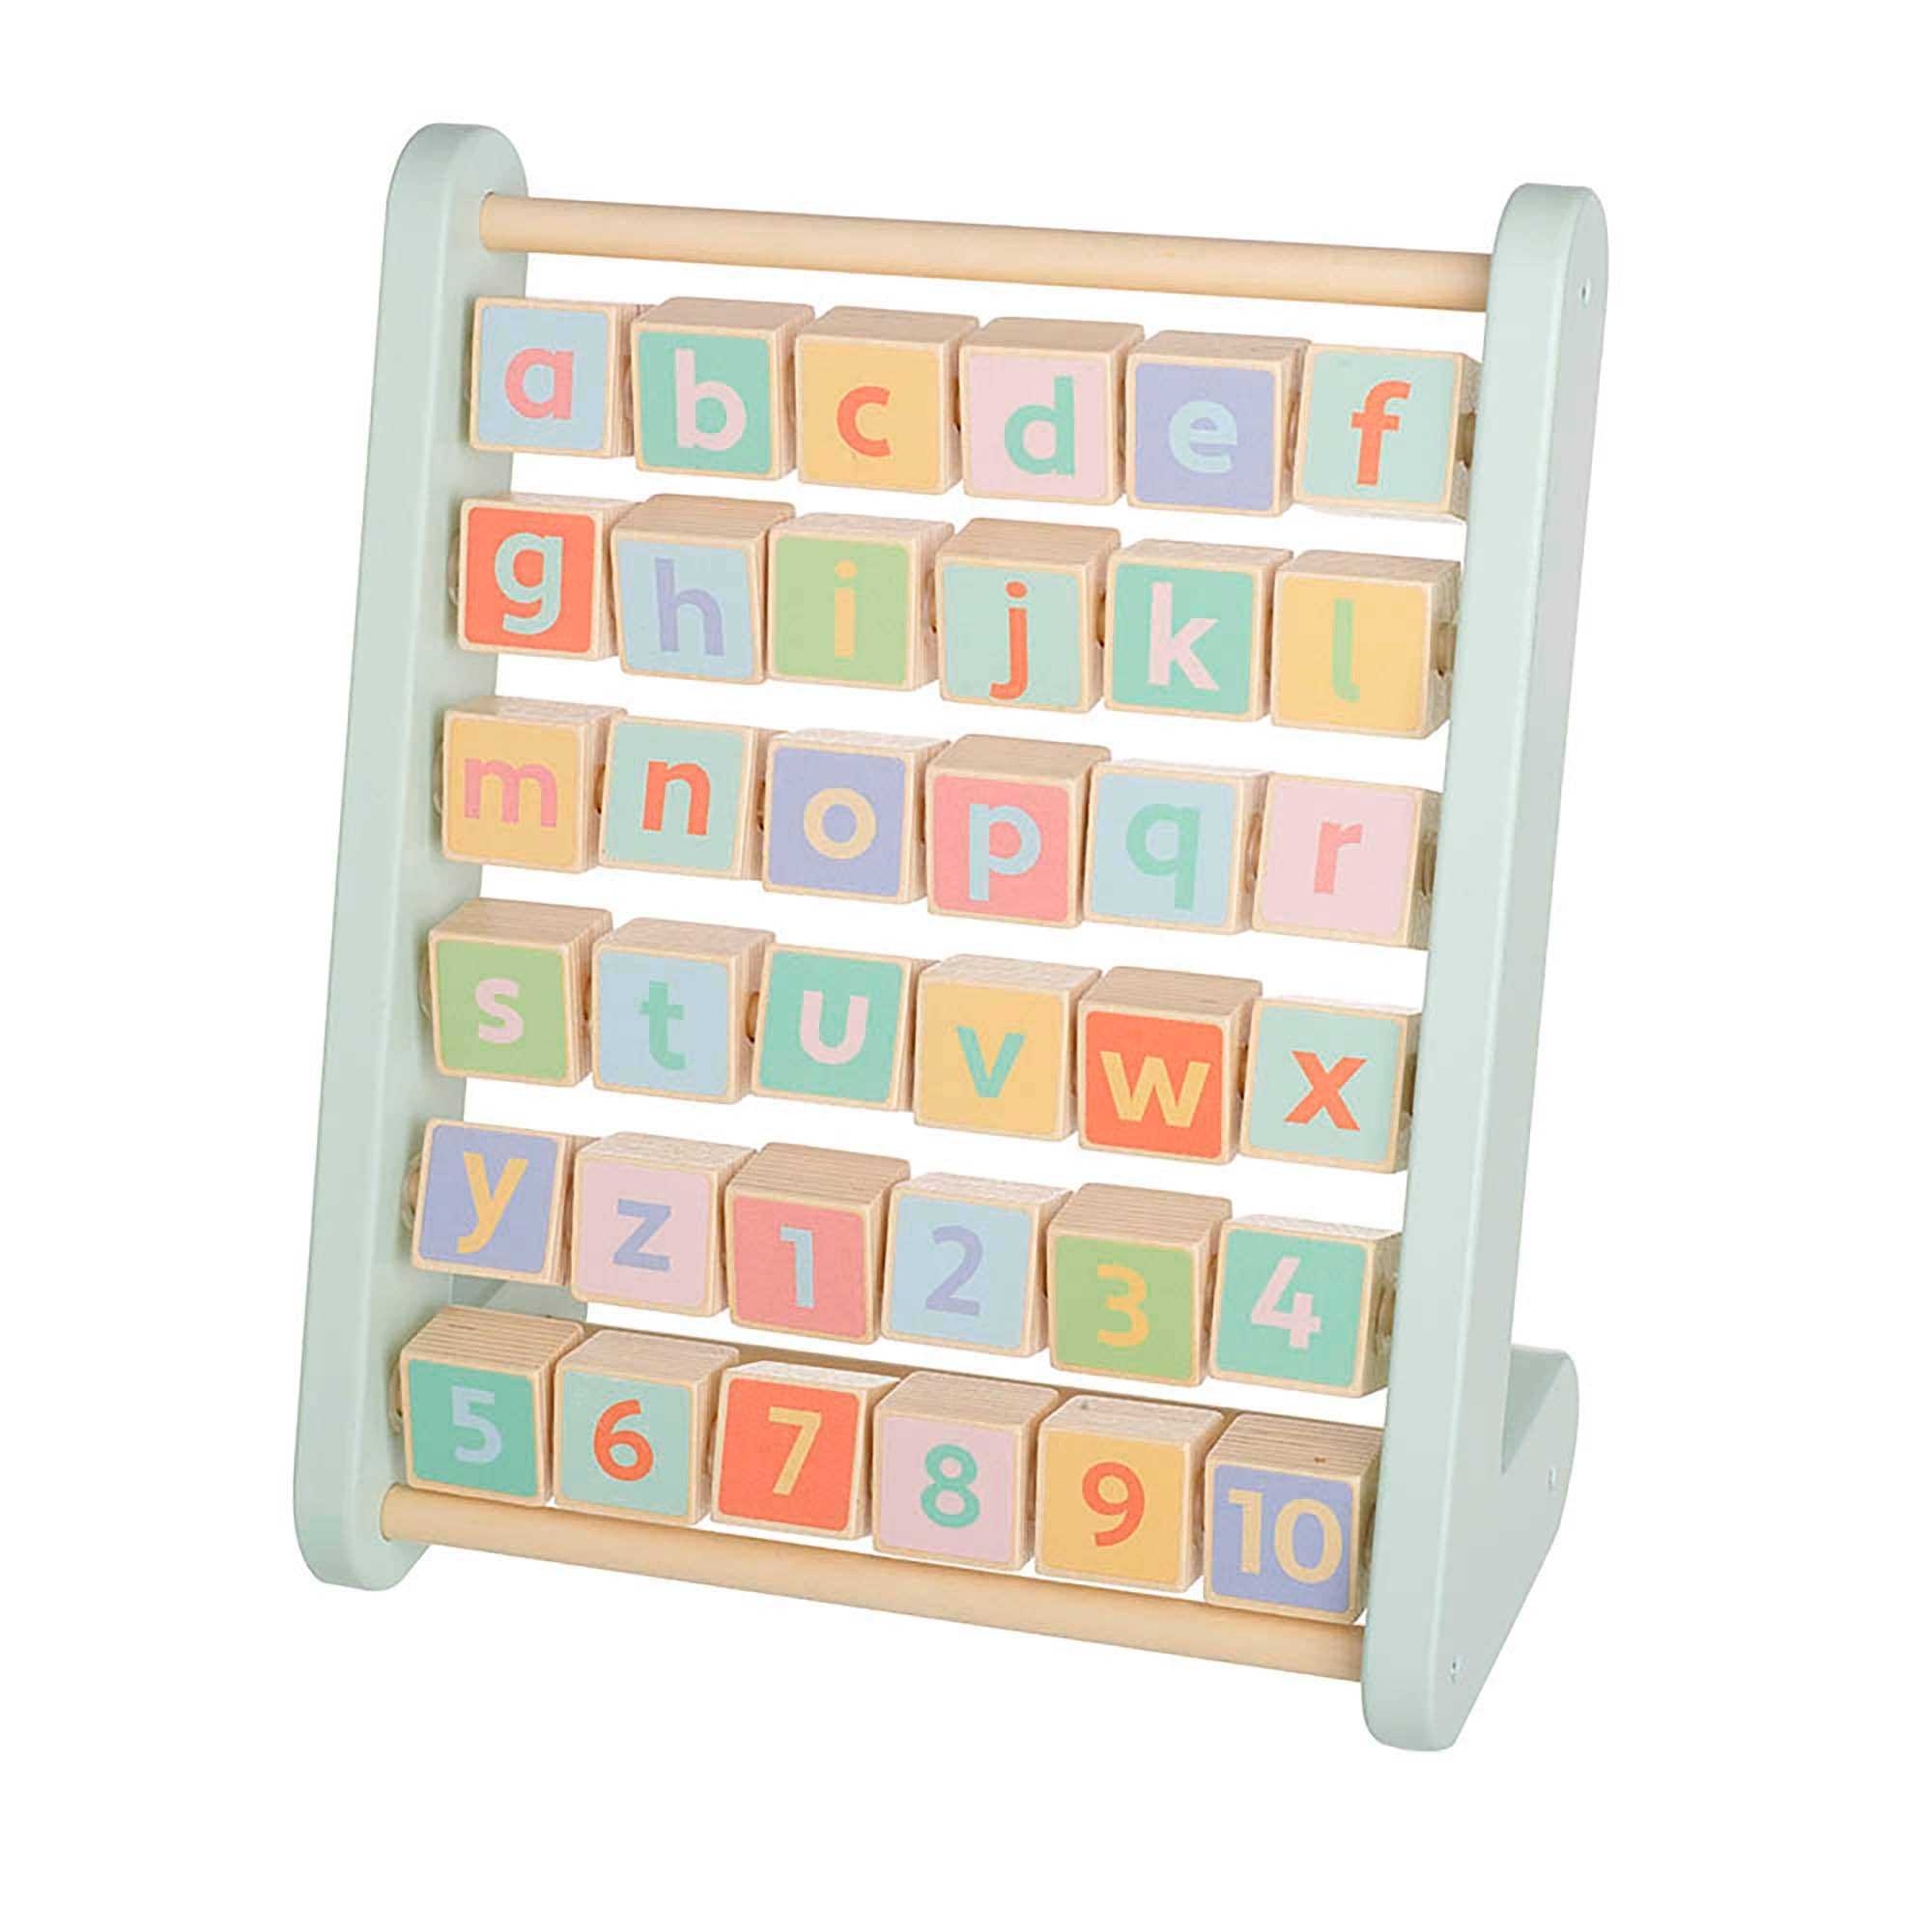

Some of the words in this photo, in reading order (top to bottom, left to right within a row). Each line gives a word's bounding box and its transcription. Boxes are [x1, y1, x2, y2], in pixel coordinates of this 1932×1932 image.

[505, 349, 573, 419] a
[675, 348, 746, 451] b
[837, 386, 891, 457] c
[1005, 376, 1075, 477] d
[1169, 401, 1236, 473] e
[1351, 381, 1410, 485] f
[495, 532, 562, 635] g
[655, 556, 724, 656] h
[835, 560, 857, 658] i
[989, 582, 1028, 700] j
[1149, 582, 1219, 691] k
[1332, 598, 1360, 703] l
[464, 758, 557, 828] m
[642, 761, 710, 836] n
[804, 788, 876, 859] o
[969, 804, 1040, 900] p
[1126, 804, 1201, 912] q
[1314, 822, 1362, 895] r
[475, 979, 523, 1043] s
[639, 980, 686, 1070] t
[800, 991, 868, 1065] u
[956, 1026, 1025, 1097] v
[1100, 1051, 1210, 1127] w
[1285, 1051, 1366, 1131] x
[458, 1151, 527, 1253] y
[612, 1198, 671, 1272] z
[781, 1226, 814, 1308] 1
[925, 1226, 983, 1316] 2
[1097, 1264, 1150, 1347] 3
[1251, 1256, 1321, 1350] 4
[451, 1386, 502, 1463] 5
[594, 1400, 653, 1481] 6
[769, 1406, 821, 1494] 7
[921, 1444, 980, 1528] 8
[1082, 1463, 1145, 1547] 9
[1229, 1489, 1342, 1582] 10
